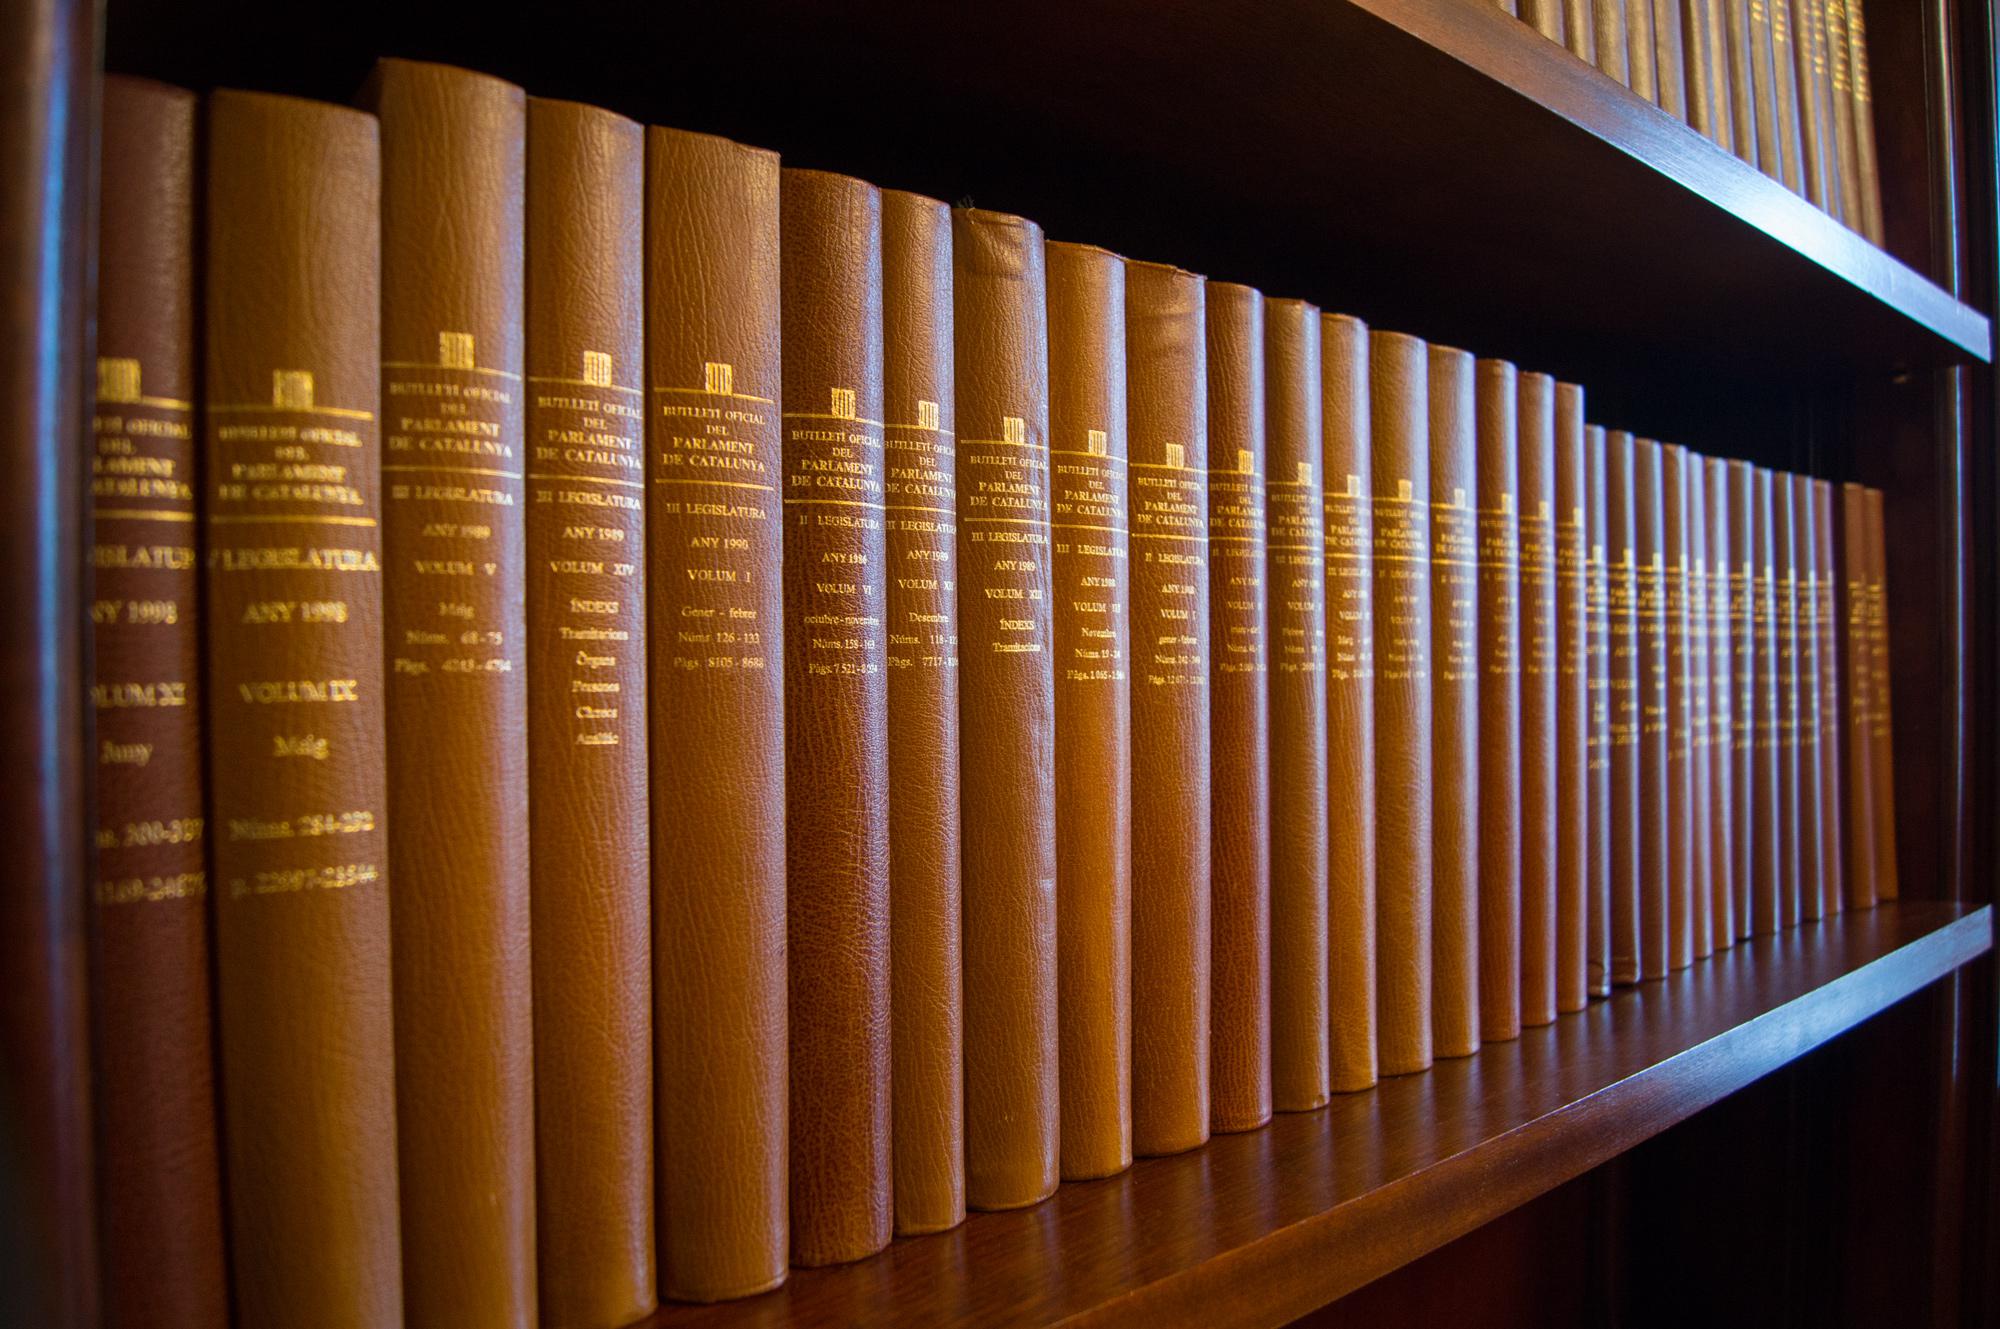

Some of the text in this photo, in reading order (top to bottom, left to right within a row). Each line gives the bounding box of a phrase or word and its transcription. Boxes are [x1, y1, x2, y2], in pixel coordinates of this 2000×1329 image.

[602, 403, 642, 419] OFICIAL
[583, 416, 608, 430] DEL
[725, 411, 765, 425] OFICIAL
[400, 417, 501, 438] PARLAMENT
[706, 425, 729, 436] DEL
[548, 429, 632, 450] PARLAMENT
[673, 436, 754, 455] PARLAMENT
[848, 434, 881, 448] OFICIAL
[417, 438, 513, 458] CATALUNYA
[832, 447, 853, 459] DEL
[536, 447, 642, 469] DE CATALUNYA
[663, 453, 765, 473] DE CATALUNYA
[919, 456, 937, 467] DEL
[801, 459, 873, 476] PARLAMENT
[1005, 471, 1023, 480] DEL
[791, 475, 881, 492] DE CATALUNYA
[979, 482, 1041, 495] PARLAMENT
[1089, 480, 1104, 490] DEL
[415, 486, 514, 506] LEGISLATURA
[558, 491, 642, 510] LEGISLATURA
[1064, 490, 1120, 504] PARLAMENT
[970, 496, 1048, 511] DE CATALUNYA
[1057, 504, 1072, 513] DE
[1144, 501, 1199, 514] PARLAMENT
[667, 503, 767, 520] III LEGISLATURA
[817, 515, 880, 530] LEGISLATURA
[422, 523, 458, 537] ANY
[563, 526, 595, 539] ANY
[691, 538, 719, 549] ANY
[972, 532, 1049, 545] III LEGISLATURA
[906, 550, 930, 560] ANY
[1056, 544, 1069, 553] III
[821, 552, 847, 563] ANY
[415, 561, 475, 575] VOLUM
[550, 561, 635, 576] VOLUM XIV
[994, 561, 1017, 571] ANY
[687, 569, 752, 583] VOLUM I
[1080, 576, 1100, 587] ANY
[816, 583, 856, 594] VOLUM
[898, 579, 937, 590] VOLUM
[1162, 583, 1180, 593] ANY
[985, 588, 1024, 599] VOLUM
[681, 606, 757, 619] Gener febrer
[1073, 602, 1107, 612] VOLUM
[908, 612, 949, 623] Desembre
[1160, 609, 1188, 619] VOLUM
